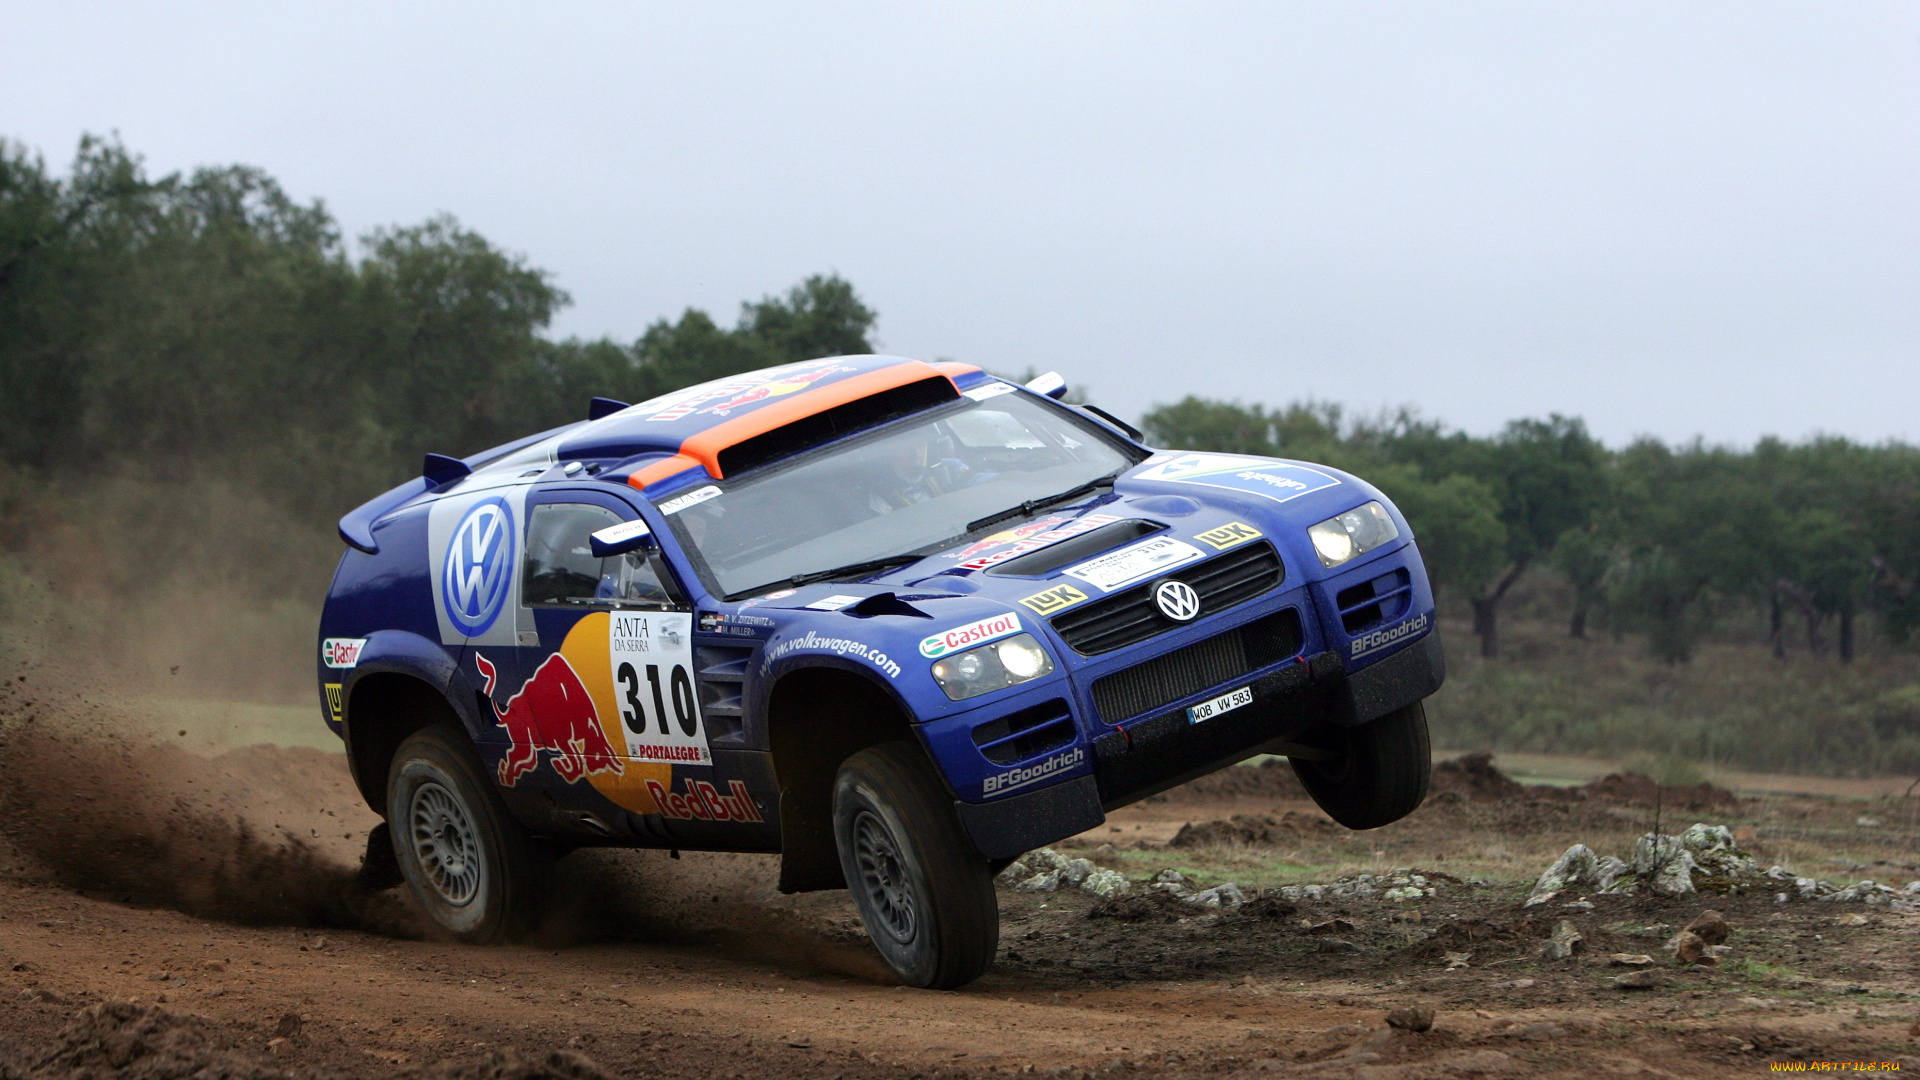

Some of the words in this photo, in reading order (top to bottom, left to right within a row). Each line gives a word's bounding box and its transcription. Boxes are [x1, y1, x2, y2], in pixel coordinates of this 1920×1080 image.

[614, 617, 650, 638] ANTA
[945, 617, 1016, 649] Castrol
[1350, 612, 1427, 656] BFGoodrich
[615, 639, 626, 651] DA
[627, 639, 650, 652] SERRA
[759, 631, 902, 679] www.volkswagen.com
[617, 661, 698, 738] 310
[1193, 704, 1213, 721] WOB
[1218, 697, 1232, 713] VW
[1232, 689, 1252, 706] 583
[639, 745, 700, 762] PORTALEGRE
[983, 747, 1084, 794] BFGoodrich
